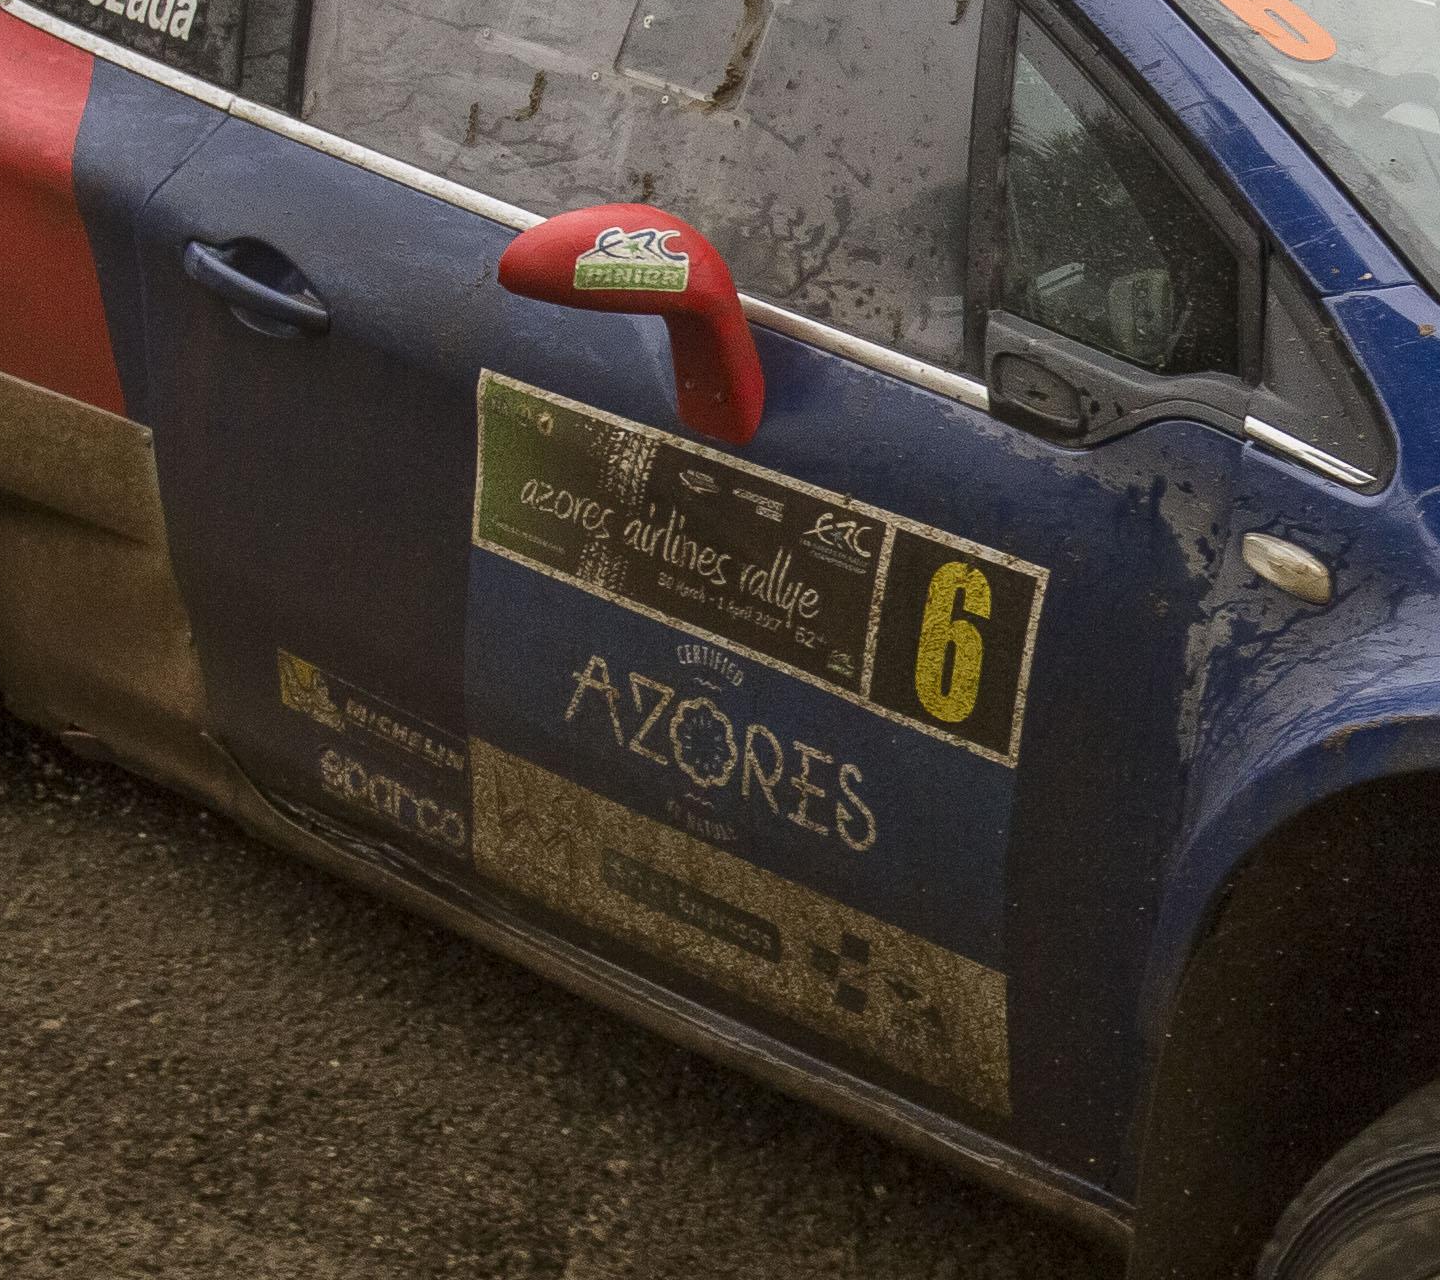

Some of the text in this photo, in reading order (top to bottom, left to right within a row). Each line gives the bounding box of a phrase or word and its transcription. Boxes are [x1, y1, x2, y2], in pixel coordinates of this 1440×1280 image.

[521, 477, 614, 540] azores
[624, 505, 731, 585] airlines
[740, 547, 820, 631] rallye
[676, 644, 743, 687] CERTIFIED
[914, 562, 991, 722] 6
[564, 654, 876, 852] AZORES
